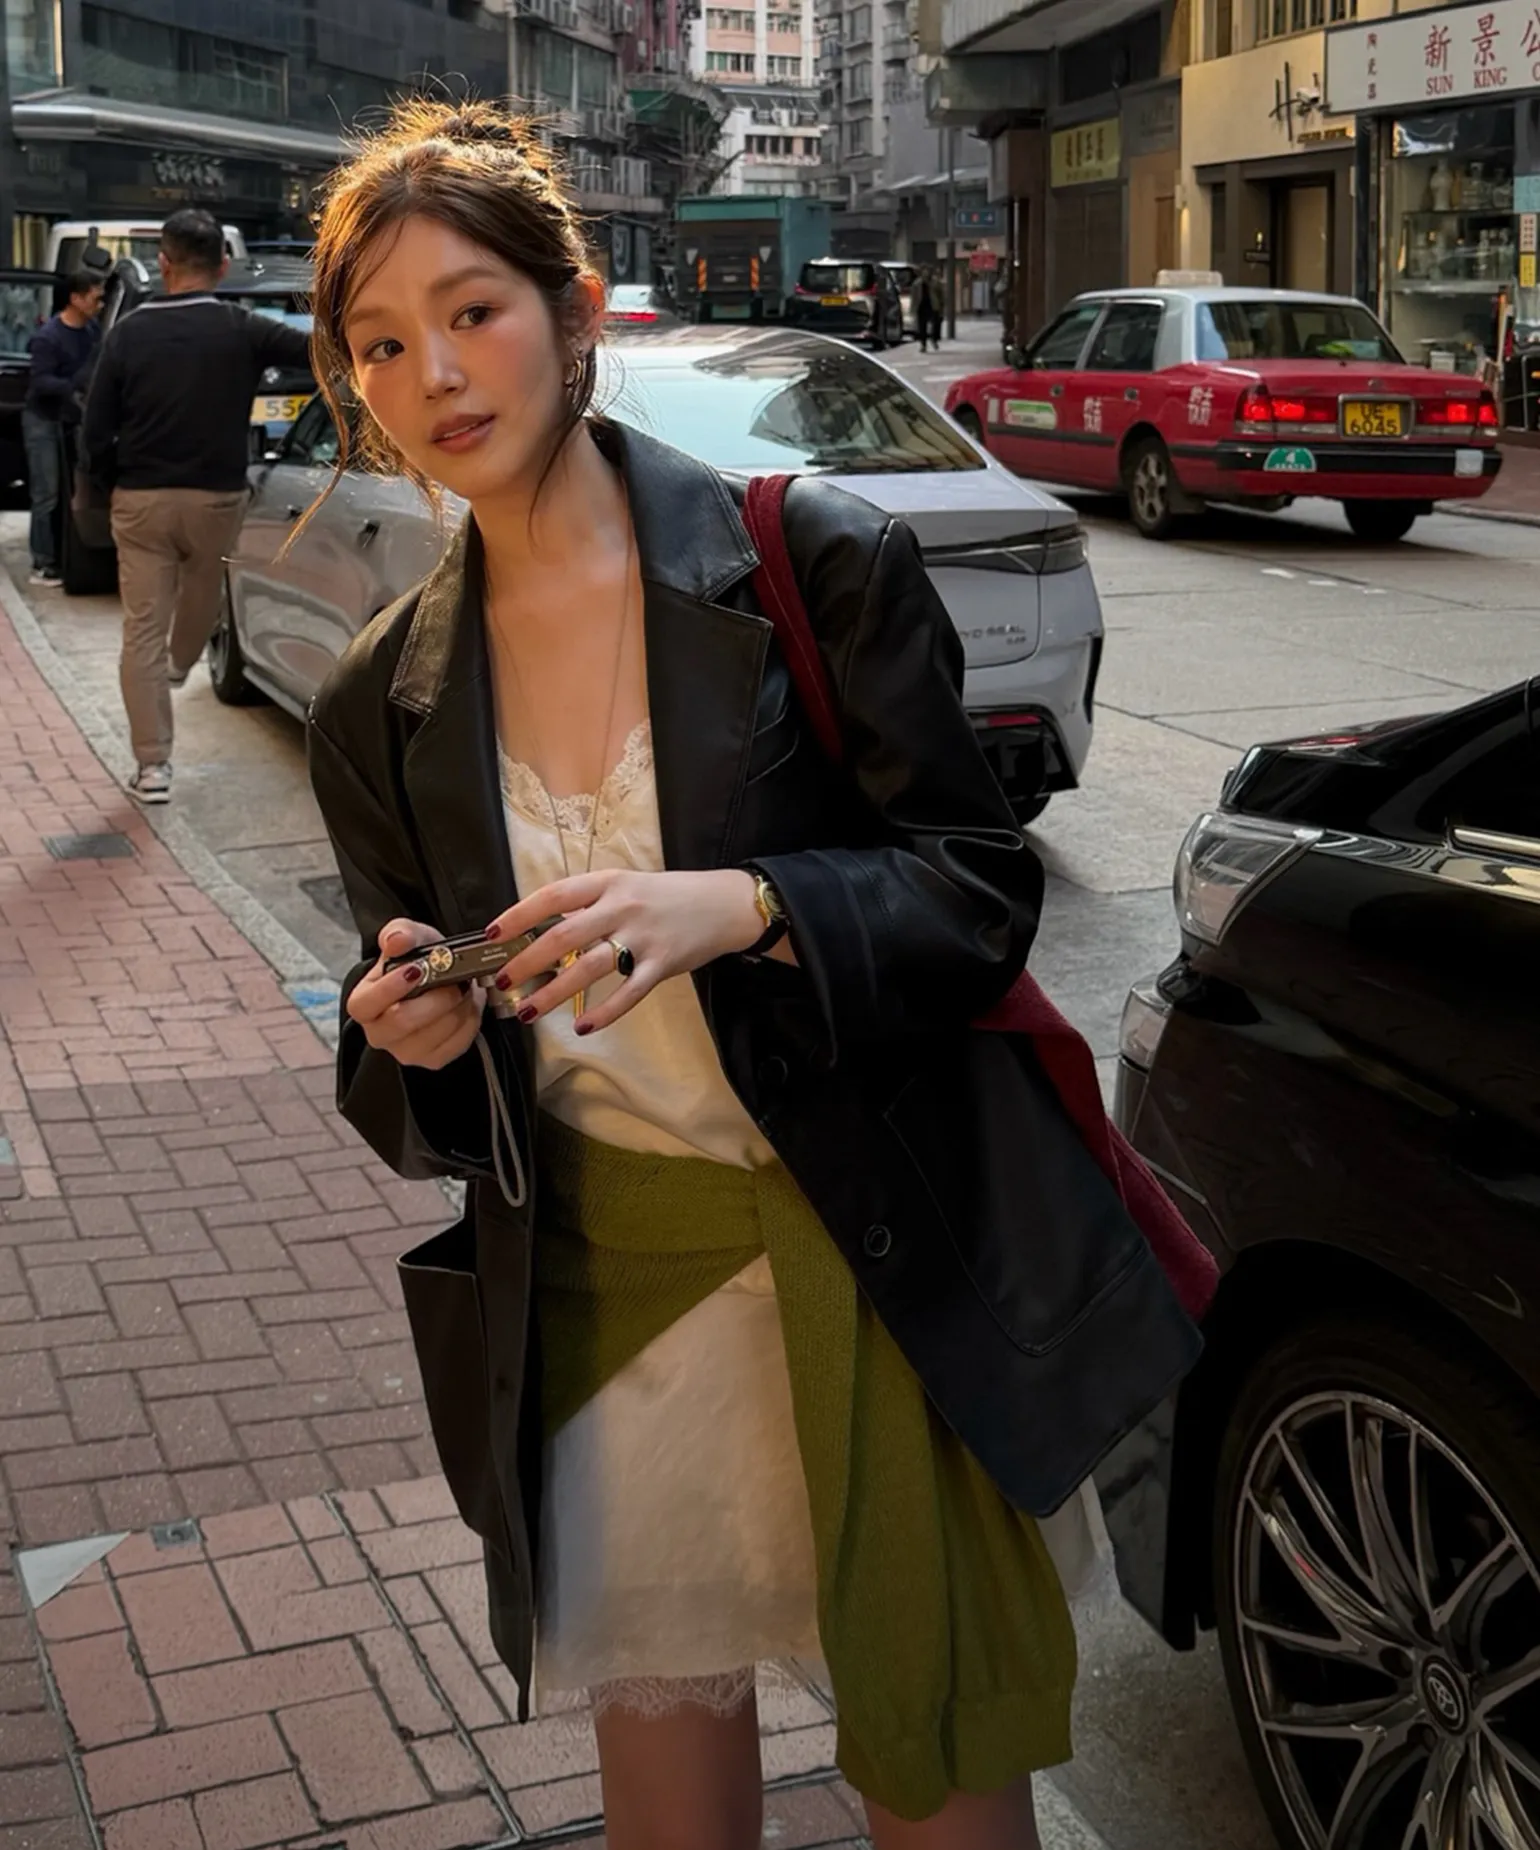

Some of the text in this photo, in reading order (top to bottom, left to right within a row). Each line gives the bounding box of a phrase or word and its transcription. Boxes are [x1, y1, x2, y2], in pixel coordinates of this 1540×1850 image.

[1426, 74, 1453, 95] SUN
[1474, 66, 1507, 89] KING
[1350, 418, 1398, 434] 6045
